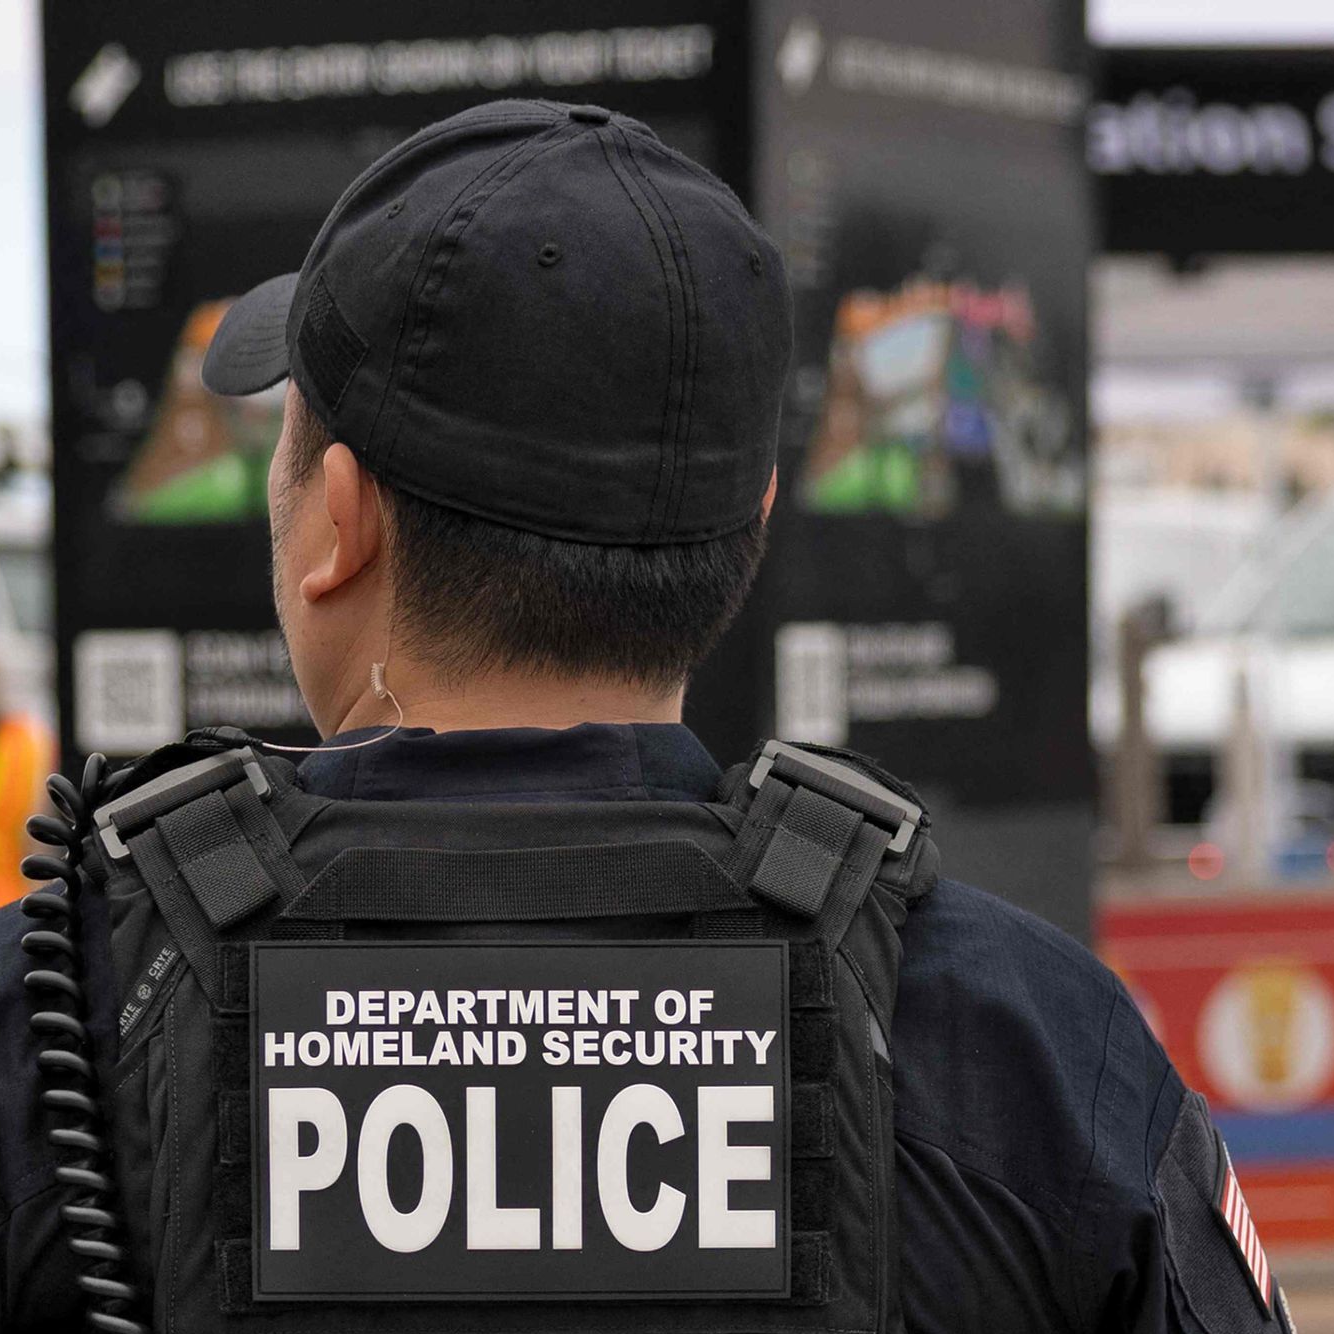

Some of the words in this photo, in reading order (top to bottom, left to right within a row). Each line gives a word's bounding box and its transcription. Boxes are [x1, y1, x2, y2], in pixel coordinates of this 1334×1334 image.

[325, 990, 639, 1025] DEPARTMENT
[654, 989, 714, 1024] OF
[264, 1031, 527, 1067] HOMELAND
[542, 1030, 777, 1066] SECURITY
[268, 1083, 776, 1253] POLICE
